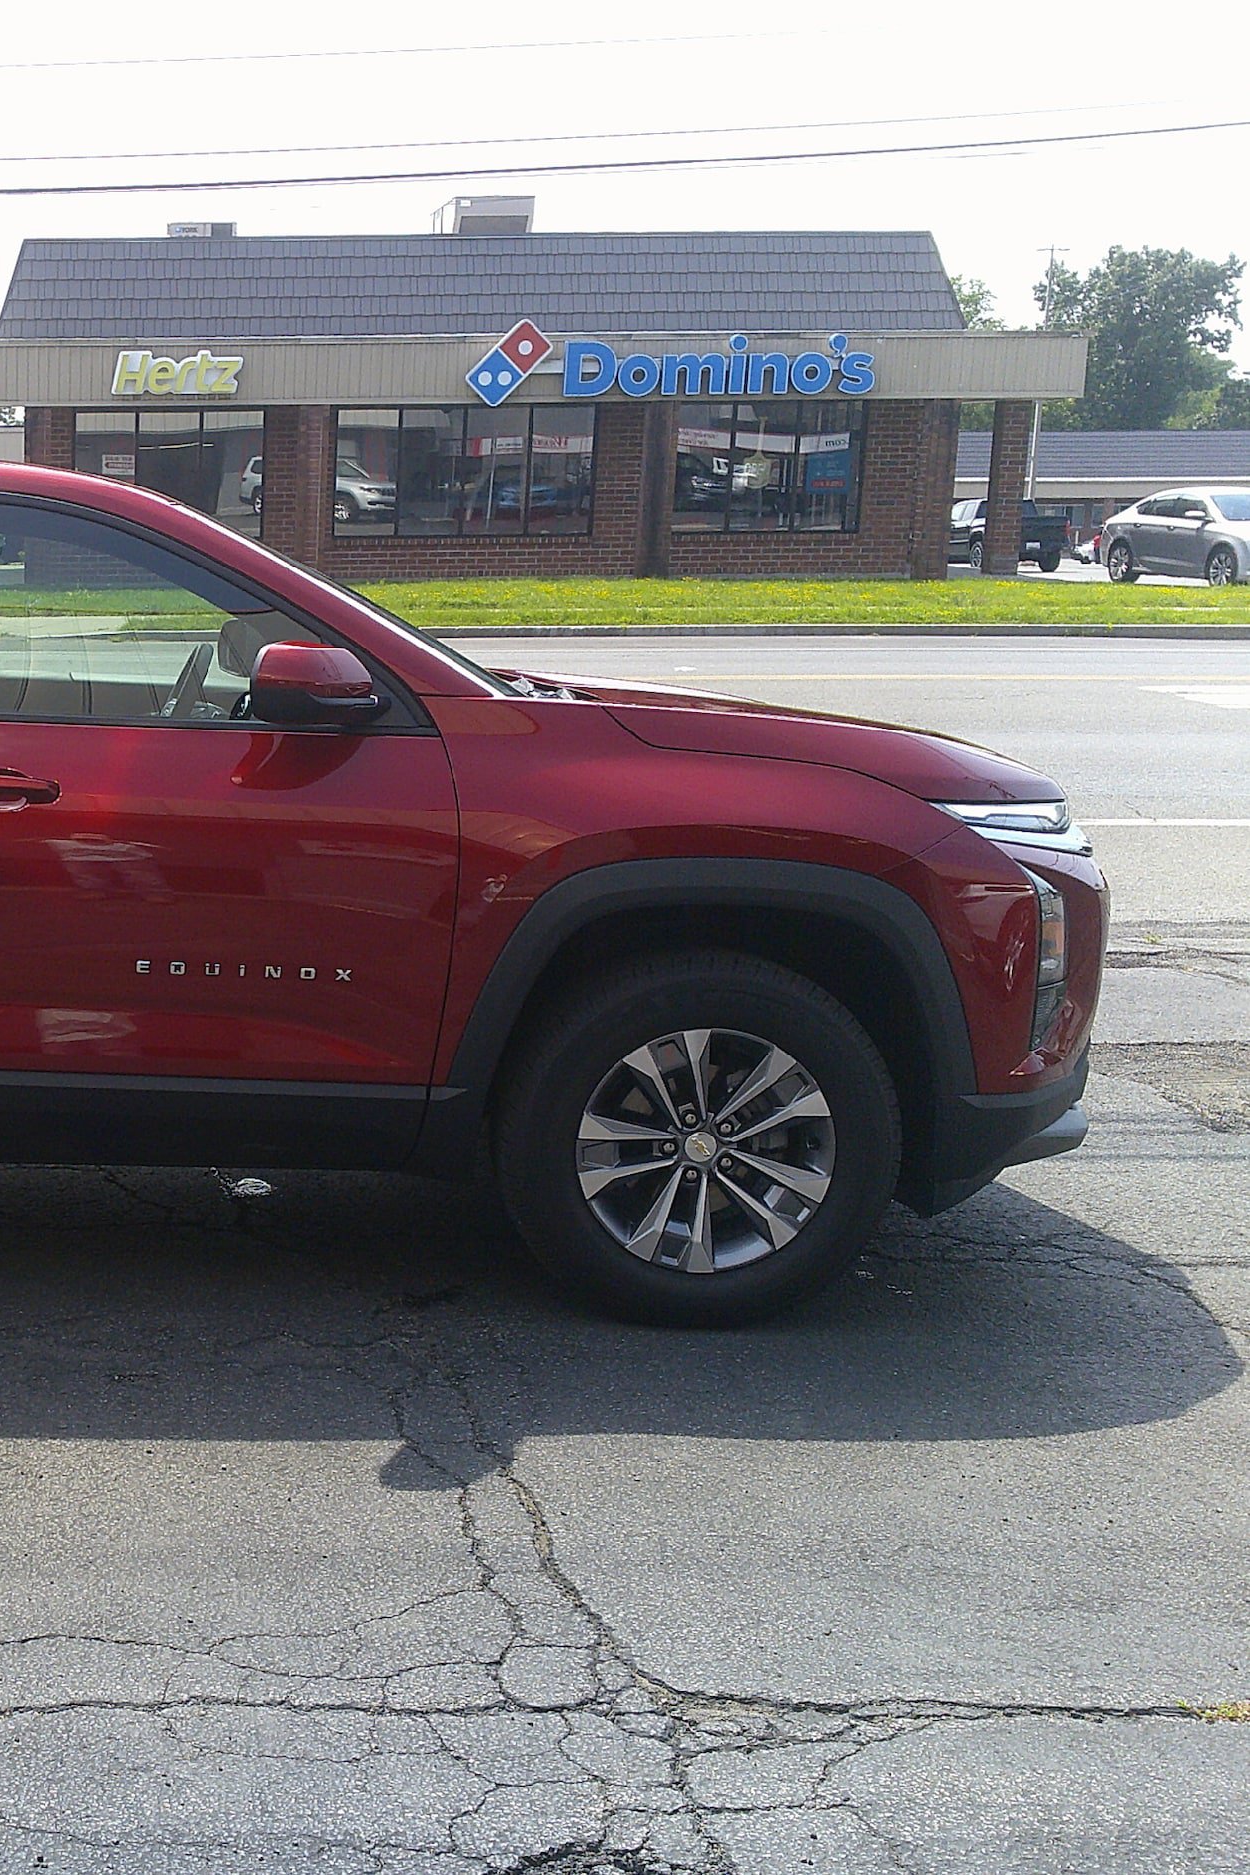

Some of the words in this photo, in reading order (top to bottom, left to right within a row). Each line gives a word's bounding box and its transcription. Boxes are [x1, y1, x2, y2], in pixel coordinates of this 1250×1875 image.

[114, 353, 241, 394] Hertz
[563, 333, 876, 397] Domino's
[135, 959, 353, 982] EQUINOX
